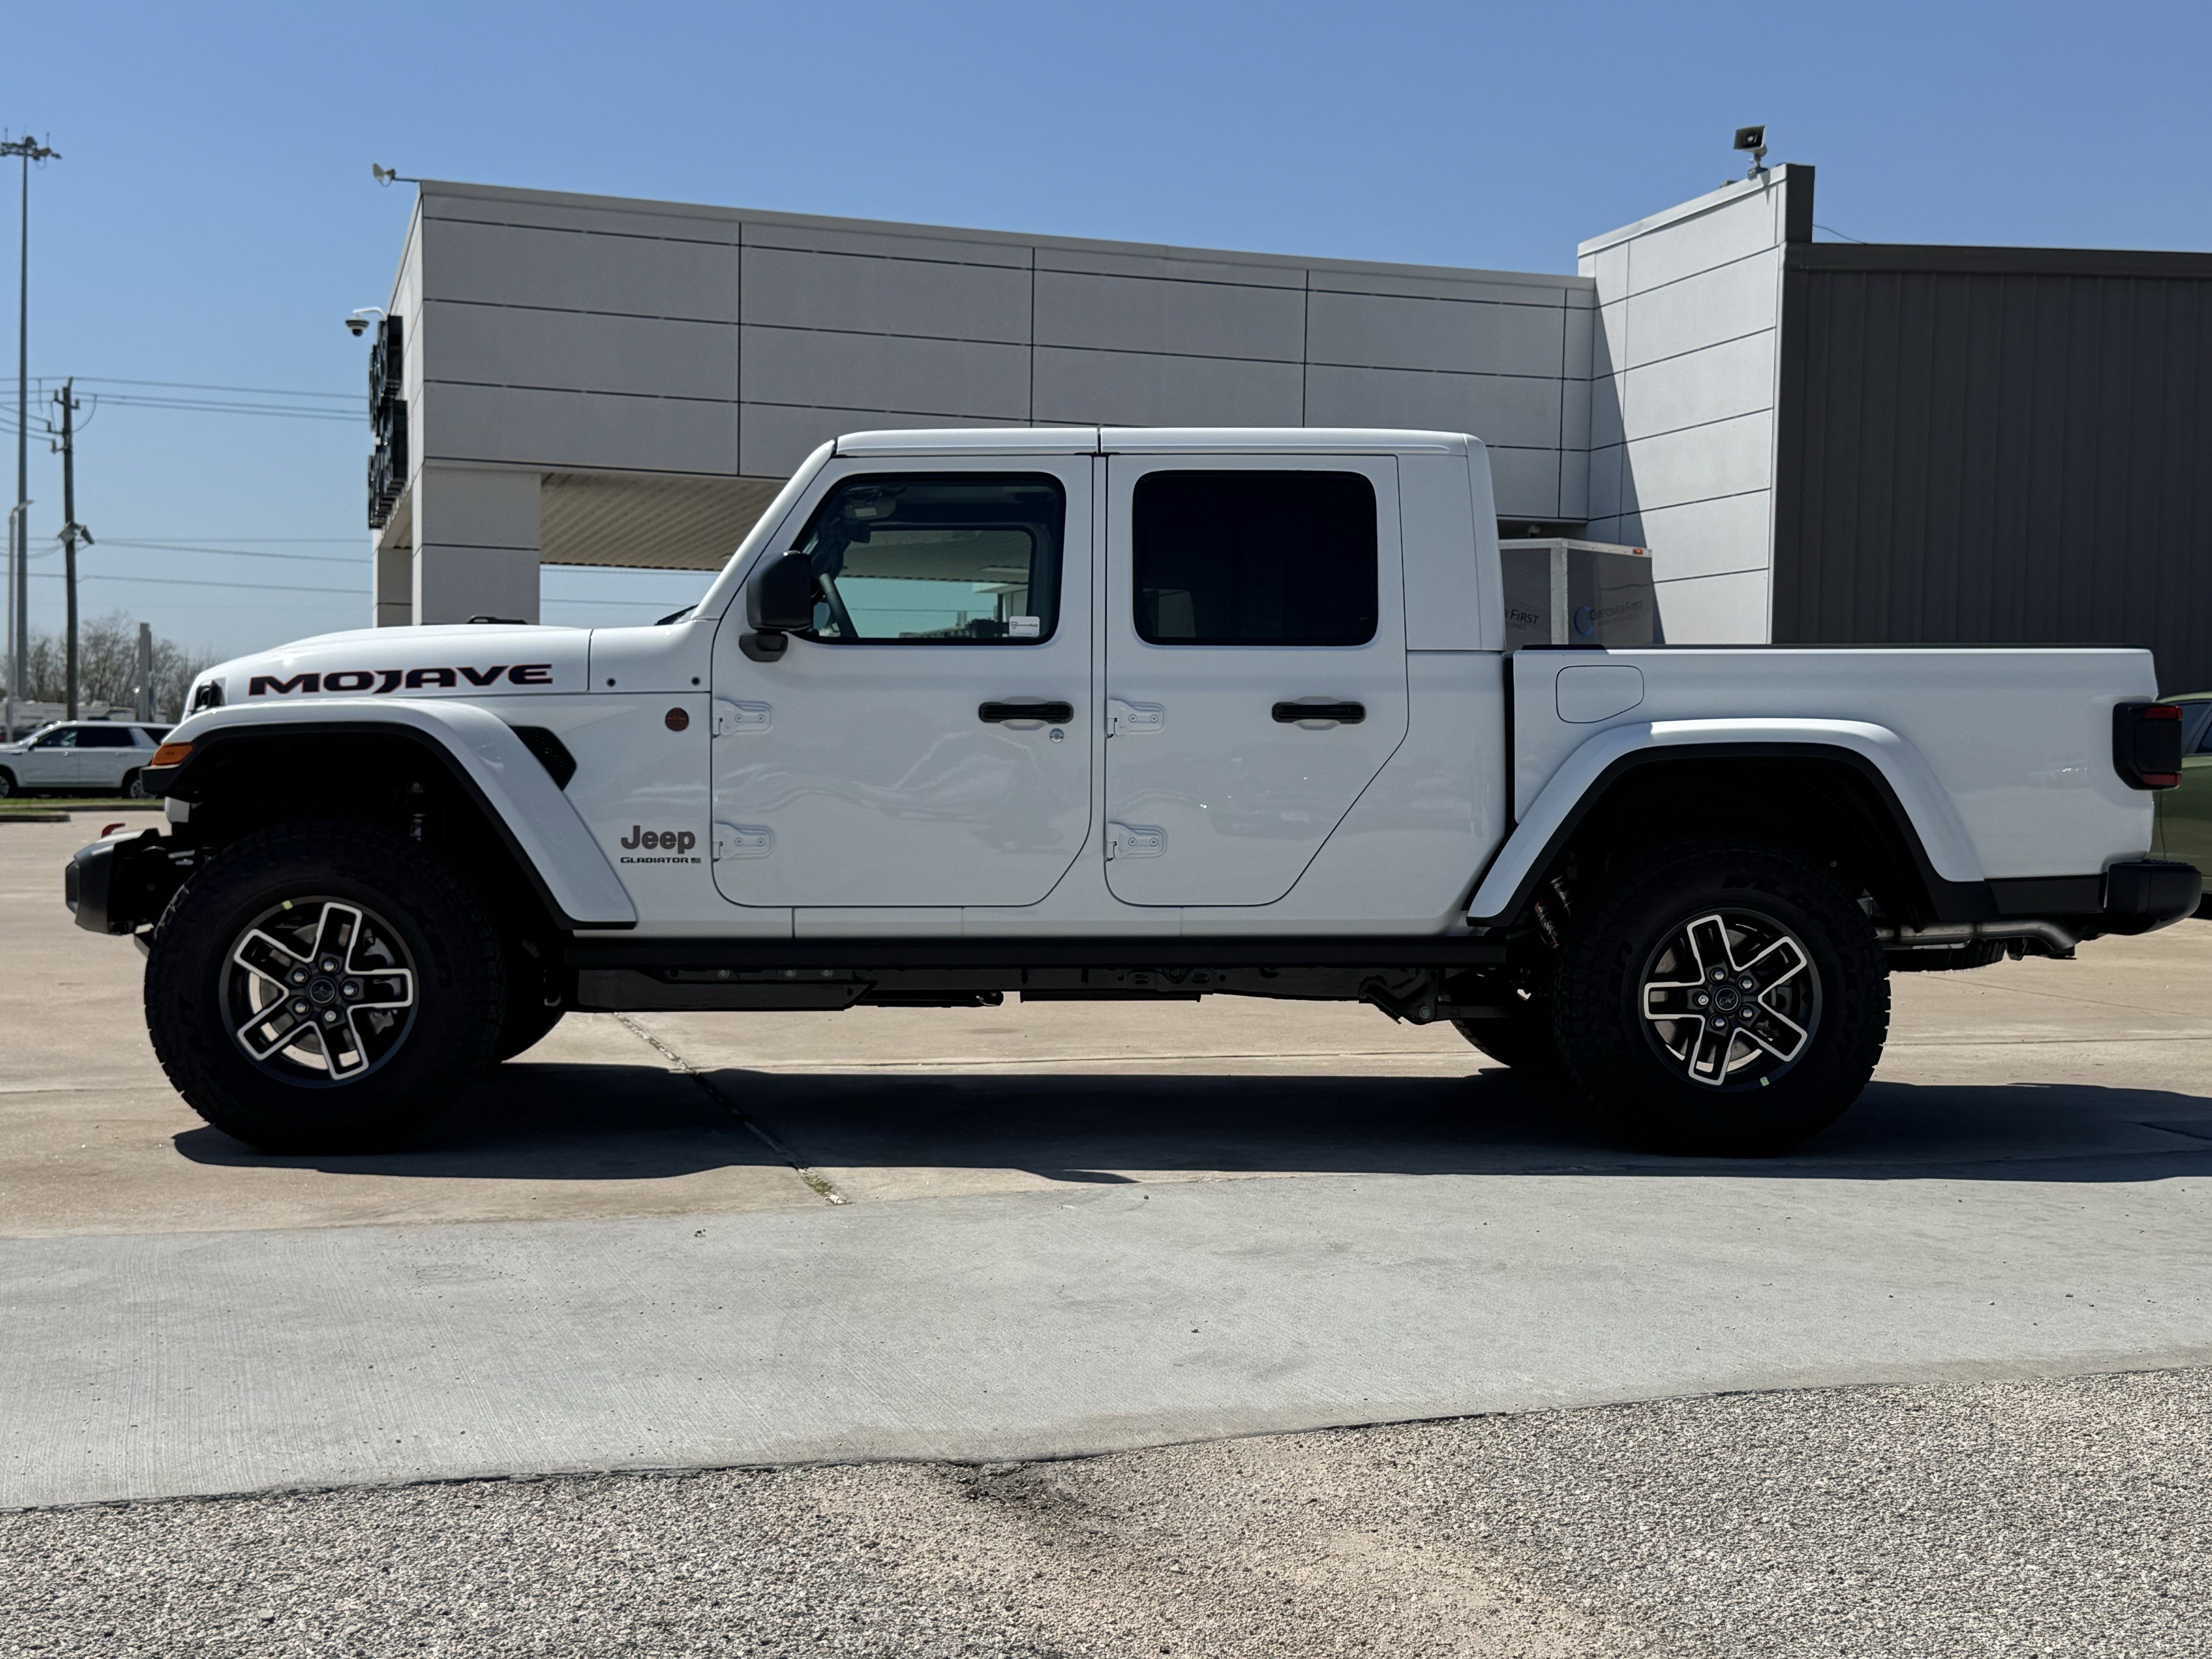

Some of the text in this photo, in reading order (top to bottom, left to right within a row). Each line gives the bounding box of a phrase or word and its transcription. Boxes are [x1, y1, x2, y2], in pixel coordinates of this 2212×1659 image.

[1510, 609, 1539, 624] FIRST
[248, 663, 553, 696] MOJAVE
[621, 825, 696, 854] Jeep
